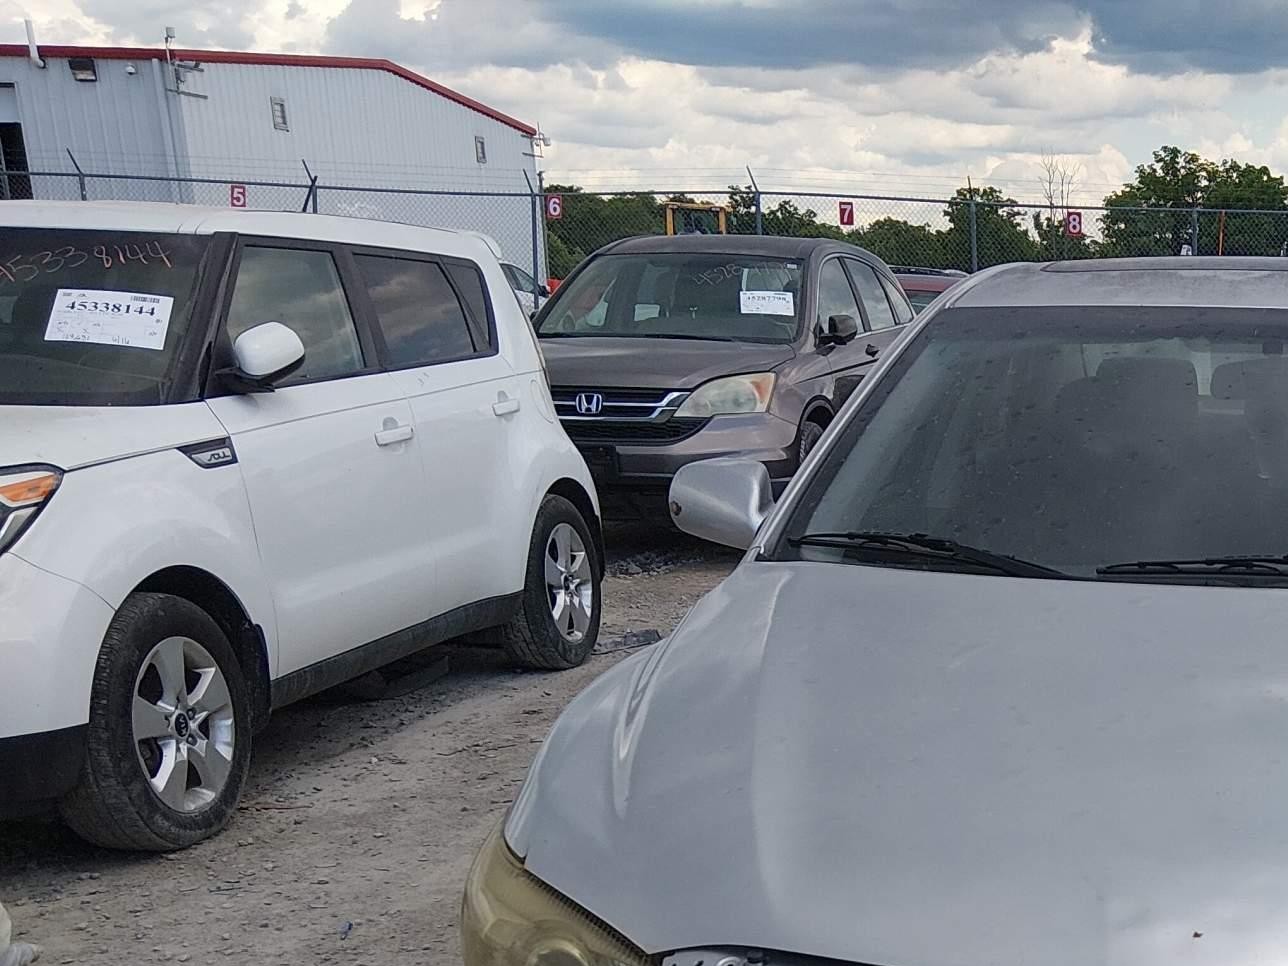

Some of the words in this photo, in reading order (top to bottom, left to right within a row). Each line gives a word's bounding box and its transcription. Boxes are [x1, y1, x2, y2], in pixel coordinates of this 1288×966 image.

[233, 187, 245, 206] 5
[549, 197, 561, 216] 6
[840, 204, 852, 224] 7
[1068, 214, 1081, 234] 8
[65, 300, 156, 317] 45338144
